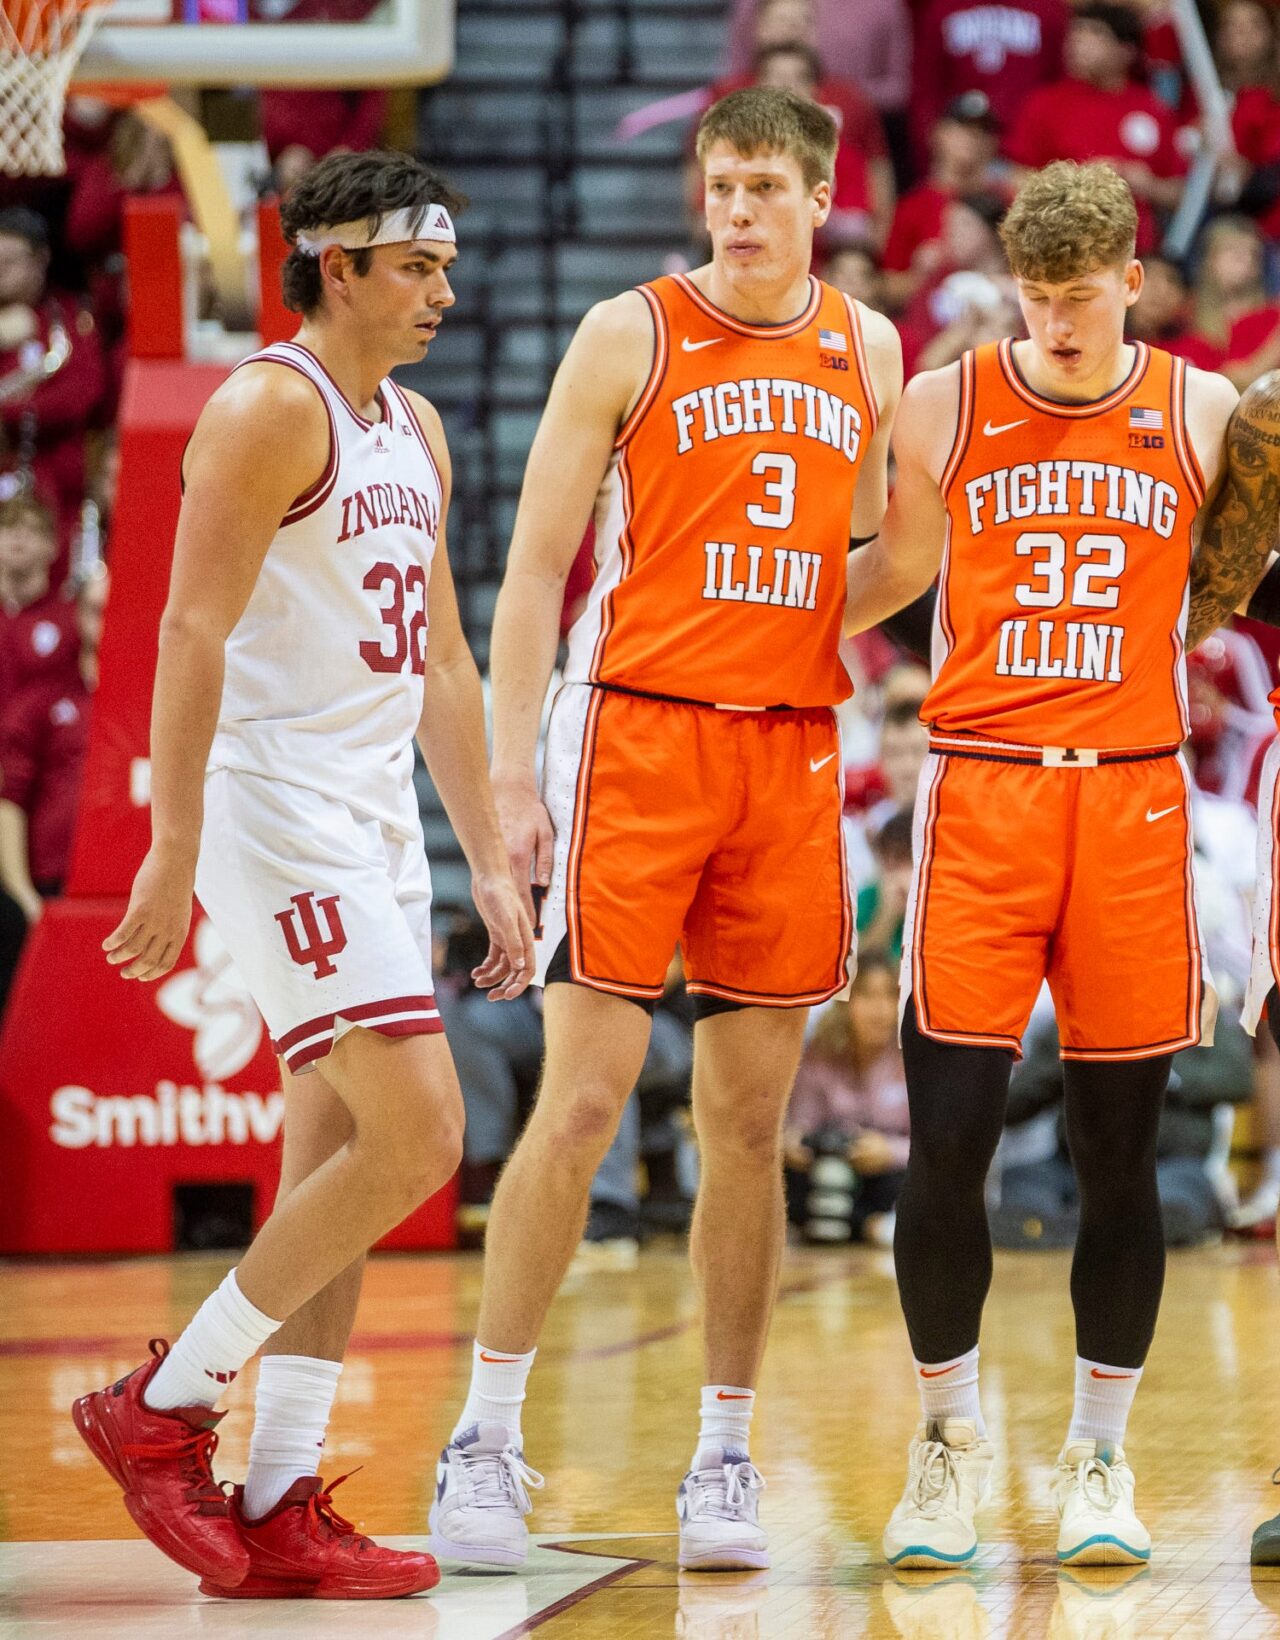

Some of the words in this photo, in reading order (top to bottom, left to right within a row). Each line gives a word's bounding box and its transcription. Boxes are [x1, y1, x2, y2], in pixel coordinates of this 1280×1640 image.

[672, 378, 862, 463] FIGHTING
[746, 451, 797, 529] 3
[965, 460, 1179, 540] FIGHTING
[702, 542, 822, 610] ILLINI
[1014, 532, 1127, 608] 32
[995, 620, 1126, 683] ILLINI
